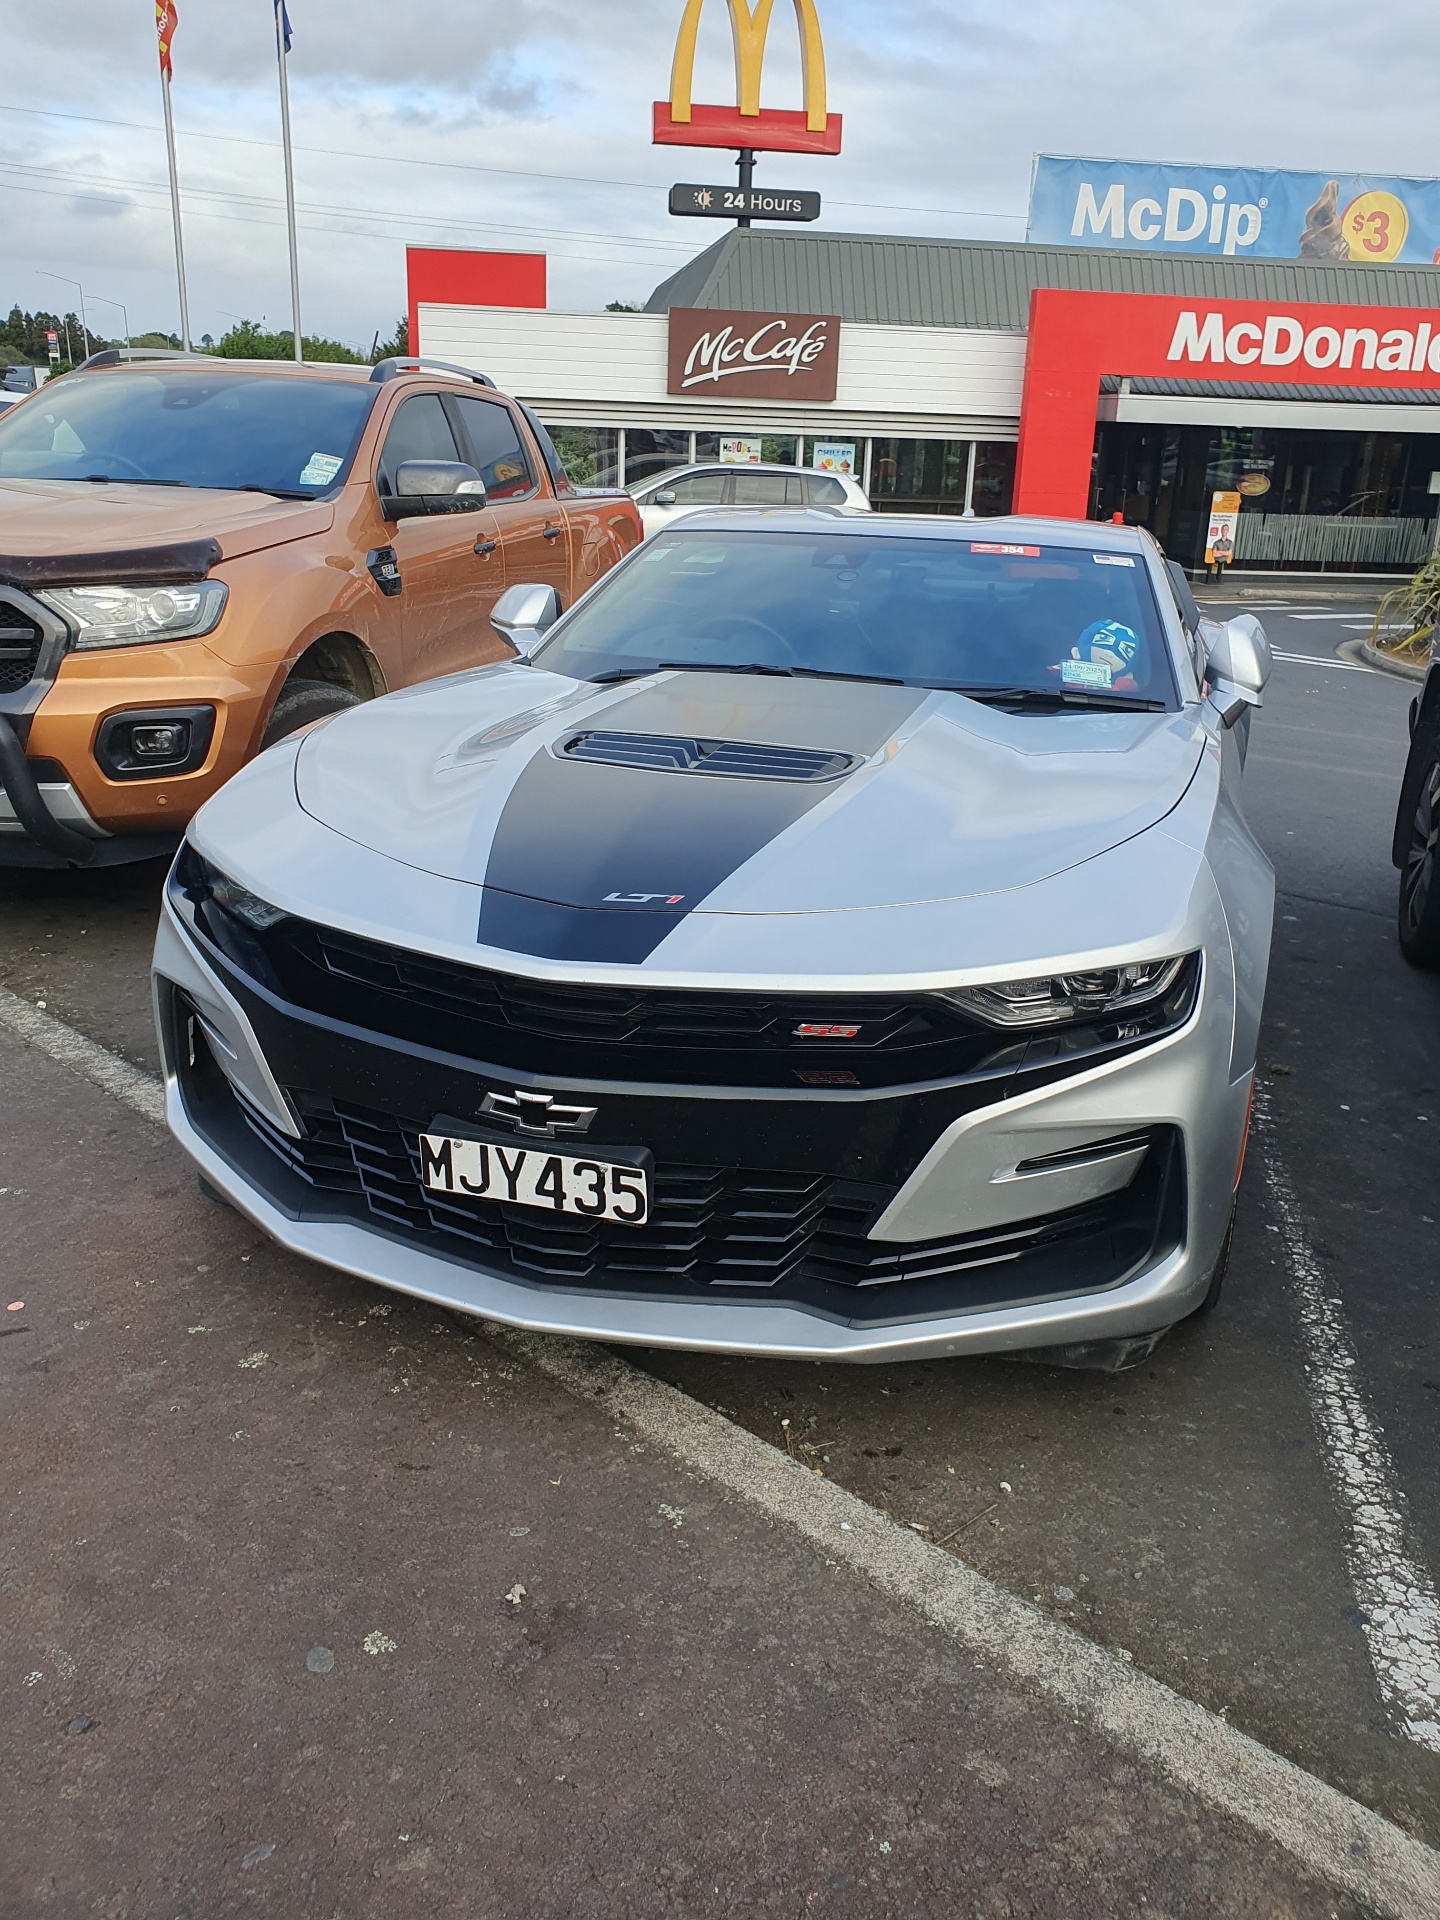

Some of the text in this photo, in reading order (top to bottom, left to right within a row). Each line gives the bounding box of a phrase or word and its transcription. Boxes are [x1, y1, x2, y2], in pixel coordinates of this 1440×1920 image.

[723, 192, 802, 212] 24 Hours
[1351, 210, 1391, 254] $3
[683, 319, 828, 382] McCafé
[1000, 545, 1025, 555] 354
[601, 892, 686, 904] LT1
[791, 1023, 862, 1038] SS
[419, 1135, 646, 1222] MJY435
